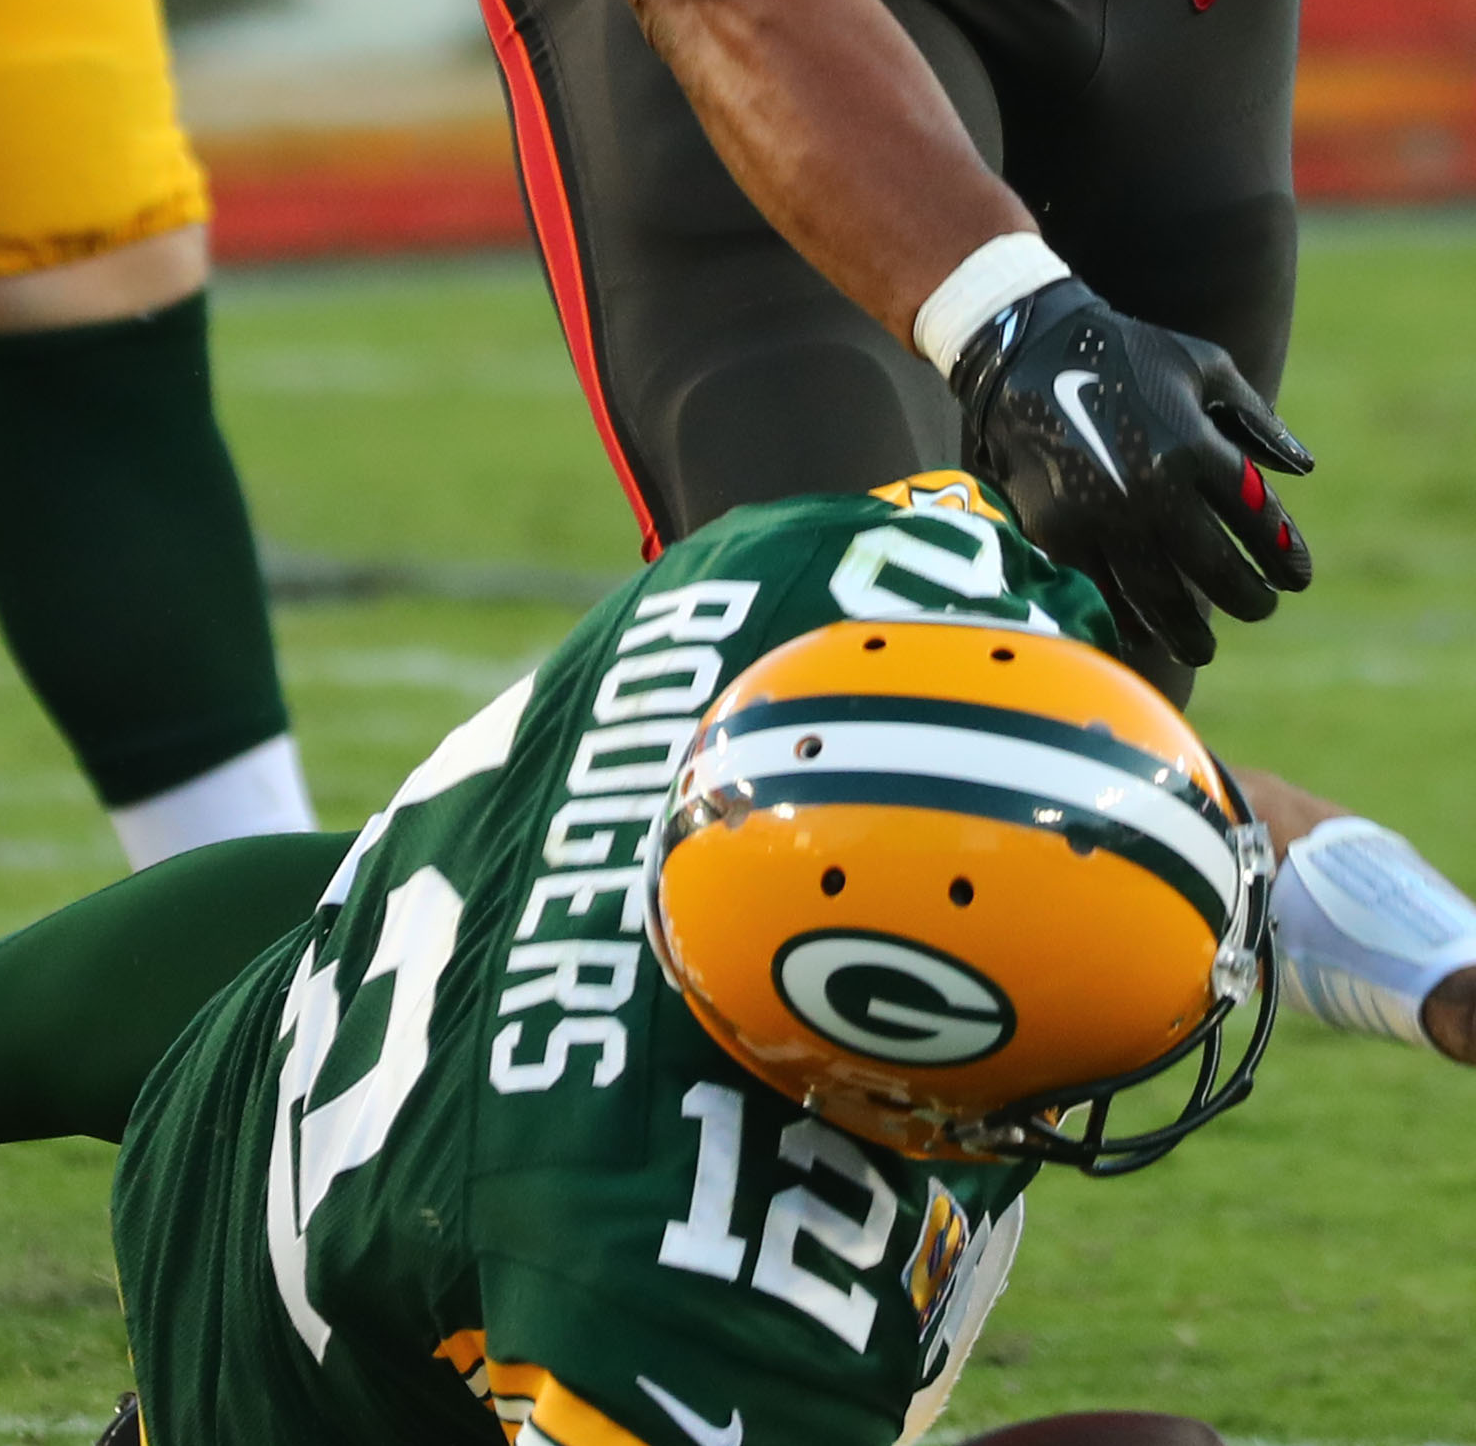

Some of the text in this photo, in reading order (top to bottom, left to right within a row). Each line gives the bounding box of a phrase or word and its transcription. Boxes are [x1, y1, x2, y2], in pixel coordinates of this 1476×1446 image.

[828, 504, 1061, 635] 2
[488, 579, 761, 1096] RODGERS
[658, 1081, 898, 1356] 12
